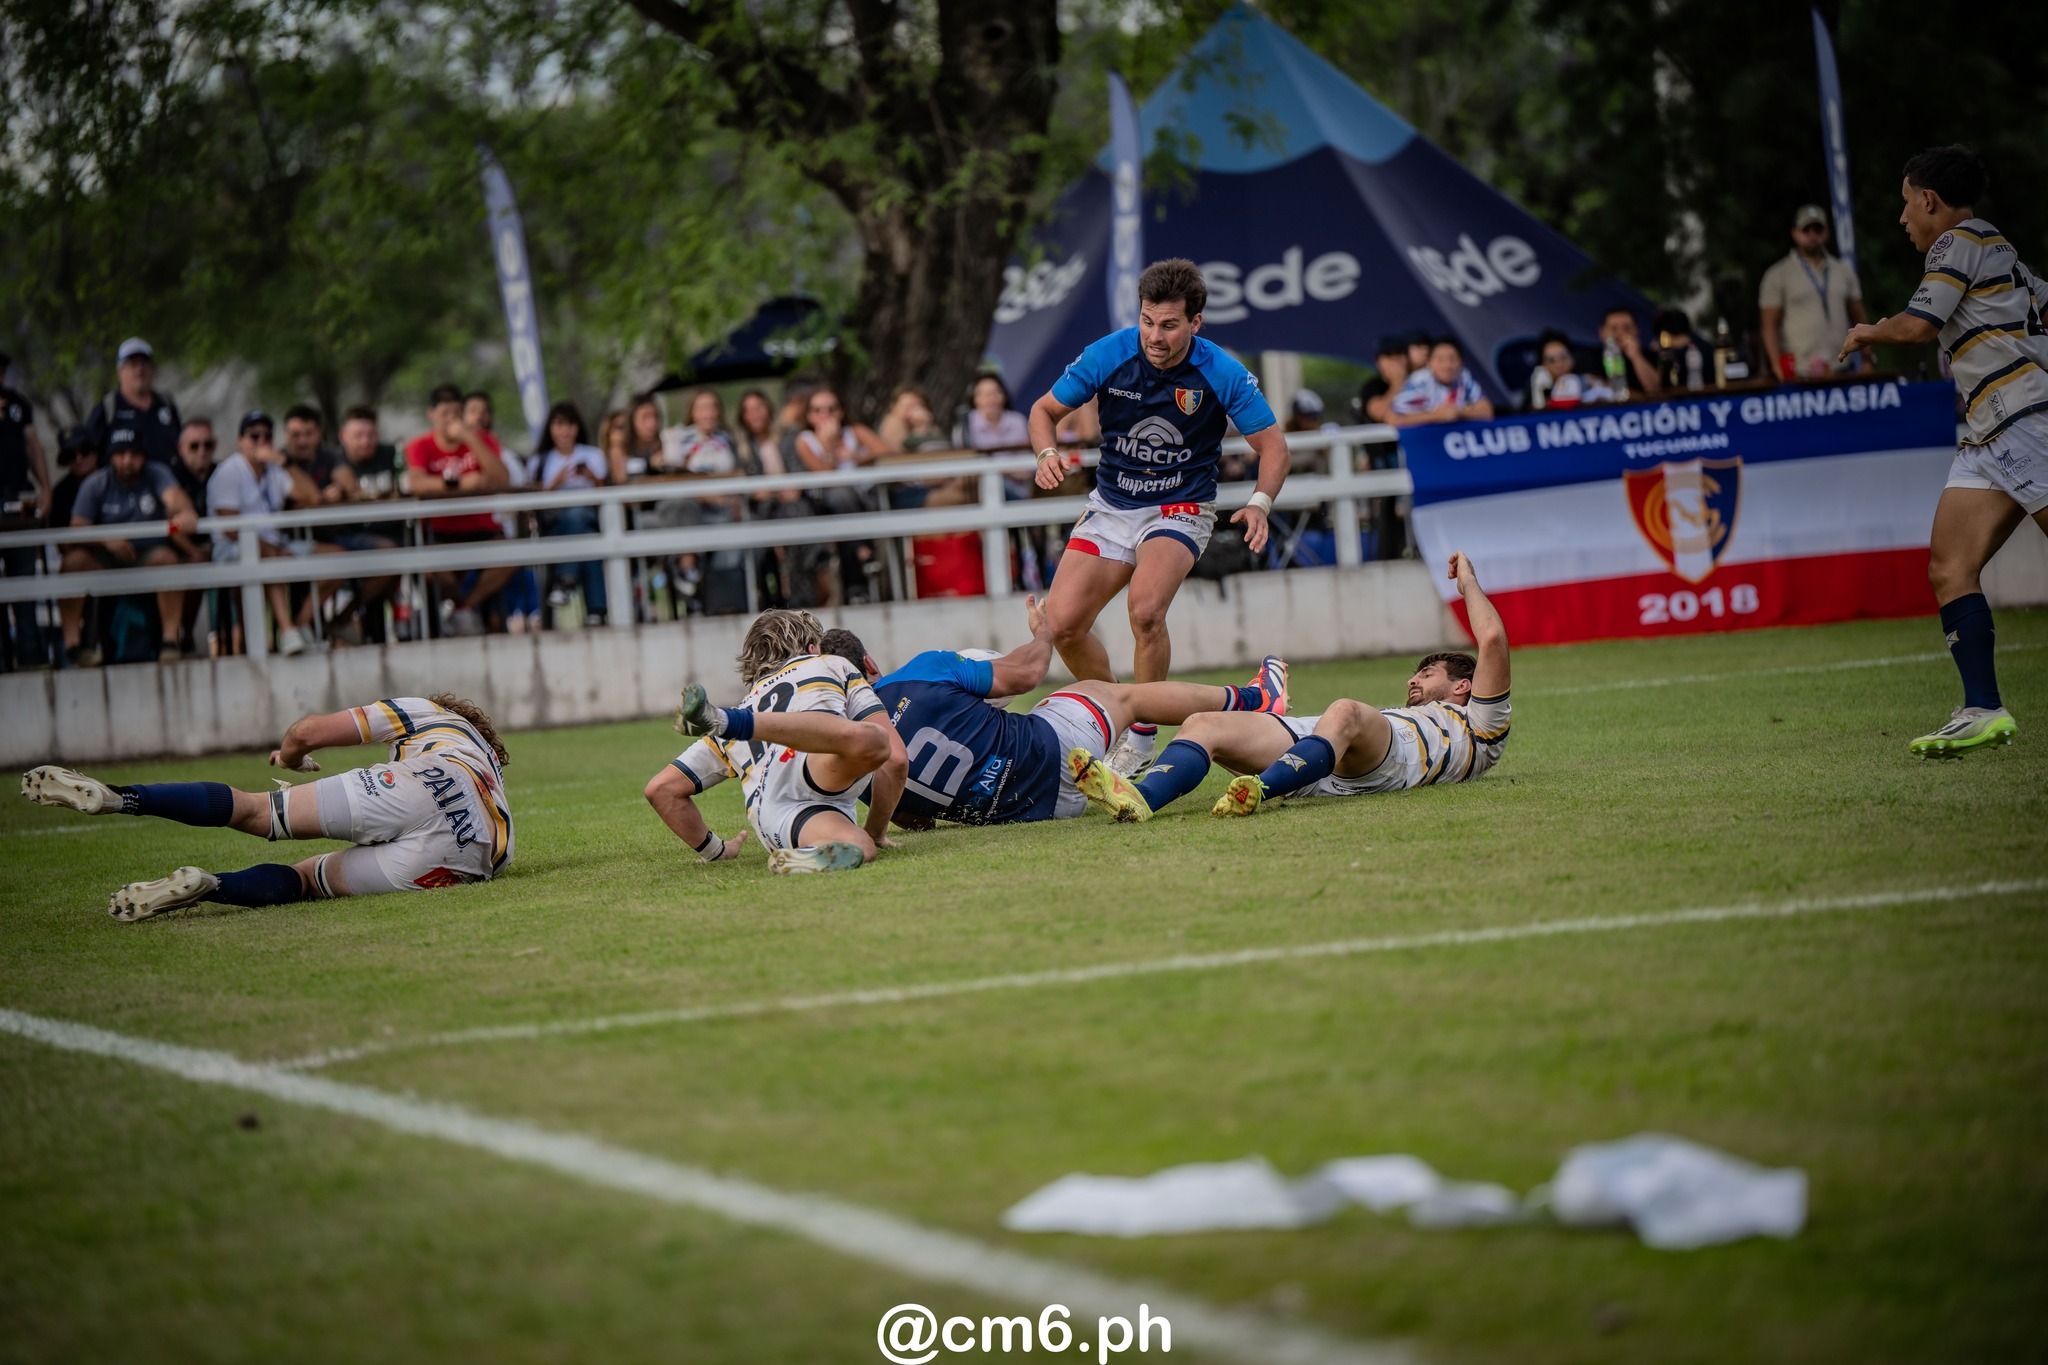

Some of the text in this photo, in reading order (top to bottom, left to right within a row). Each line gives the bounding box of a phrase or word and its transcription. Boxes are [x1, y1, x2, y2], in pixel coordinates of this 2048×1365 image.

[1108, 387, 1142, 401] PROCER
[1443, 382, 1901, 460] CLUB NATACIÓN Y GIMNASIA
[1114, 435, 1192, 464] Macro
[1116, 470, 1184, 496] Imperial
[1639, 583, 1760, 626] 2018
[904, 726, 974, 807] 13
[979, 758, 1003, 792] Alfa
[412, 766, 477, 849] PALAU
